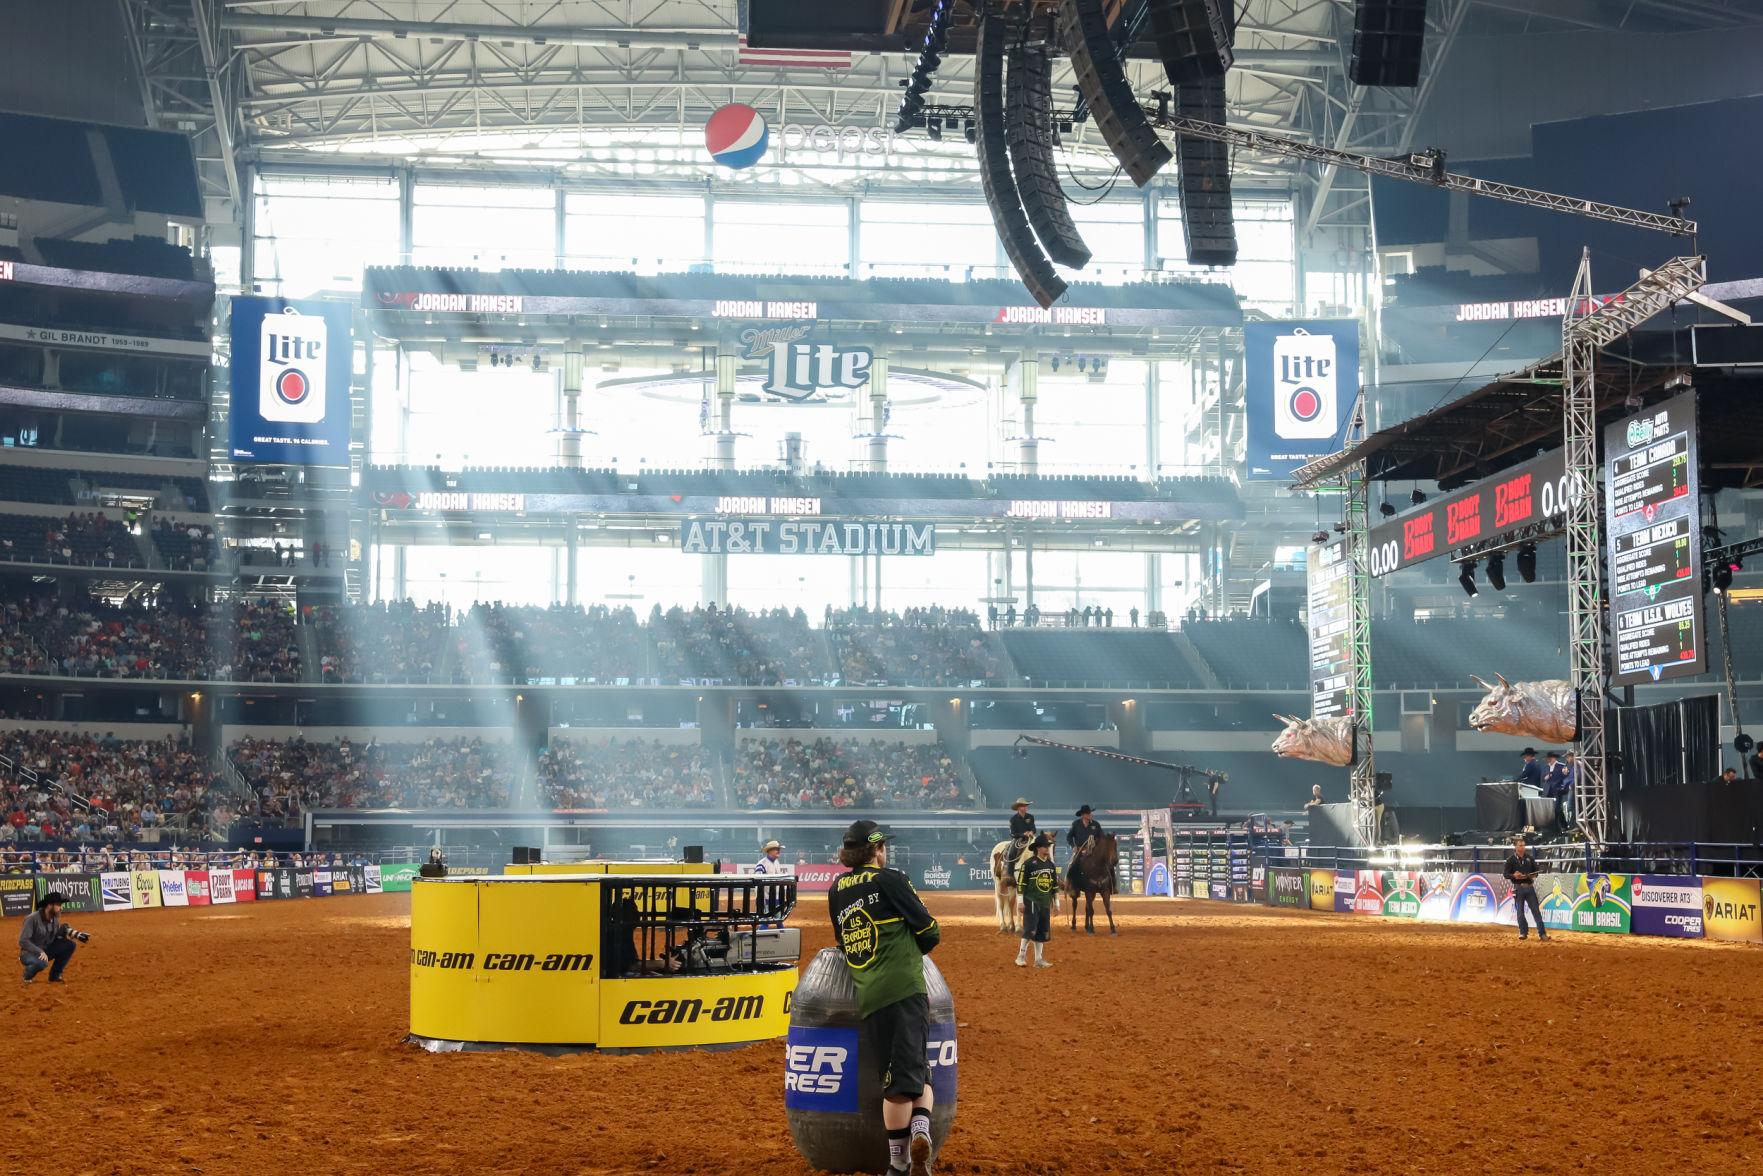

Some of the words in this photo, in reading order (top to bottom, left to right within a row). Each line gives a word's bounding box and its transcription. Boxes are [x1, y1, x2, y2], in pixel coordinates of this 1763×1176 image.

[780, 122, 895, 162] pepsi
[414, 294, 466, 310] JORDAN
[472, 296, 522, 312] HANSEN
[712, 300, 762, 317] JORDAN
[767, 302, 817, 319] HANSEN
[1456, 302, 1509, 321] JORDAN
[1514, 298, 1566, 318] HANSEN
[1002, 306, 1052, 323] JORDAN
[1056, 308, 1105, 324] HANSEN
[40, 331, 58, 341] GIL
[62, 333, 107, 345] BRANDT
[740, 325, 811, 353] Miller
[267, 334, 322, 365] Lite
[768, 342, 871, 398] Lite
[1280, 354, 1331, 384] Lite
[1629, 450, 1647, 470] TEAM
[1508, 474, 1532, 498] BOOT
[415, 492, 468, 510] JORDAN
[472, 494, 524, 511] HANSEN
[715, 496, 766, 514] JORDAN
[770, 498, 821, 514] HANSEN
[1007, 500, 1057, 517] JORDAN
[1062, 502, 1111, 518] HANSEN
[684, 522, 770, 553] AT&T
[780, 522, 934, 555] STADIUM
[1632, 529, 1650, 547] TEAM
[1652, 521, 1677, 542] MEXICO
[1371, 540, 1398, 576] 0.00
[1625, 611, 1643, 628] TEAM
[1664, 600, 1692, 620] WOLVES
[218, 874, 230, 886] BOOT
[333, 872, 348, 881] ARIAT
[800, 872, 831, 882] LUCAS
[48, 878, 90, 898] MONSTER
[1315, 886, 1334, 896] ARIAT
[1642, 891, 1678, 903] DISCOVERER
[868, 893, 880, 905] BY
[1578, 911, 1594, 926] TEAM
[1596, 912, 1621, 927] BRASIL
[1665, 915, 1701, 926] COOPER
[1715, 902, 1756, 921] ARIAT
[850, 916, 863, 928] U.S.
[844, 928, 871, 944] BORDER
[845, 940, 872, 955] PATROL
[417, 950, 474, 969] can-am
[483, 954, 593, 971] can-am
[619, 995, 764, 1025] can-am
[786, 1072, 843, 1093] RES
